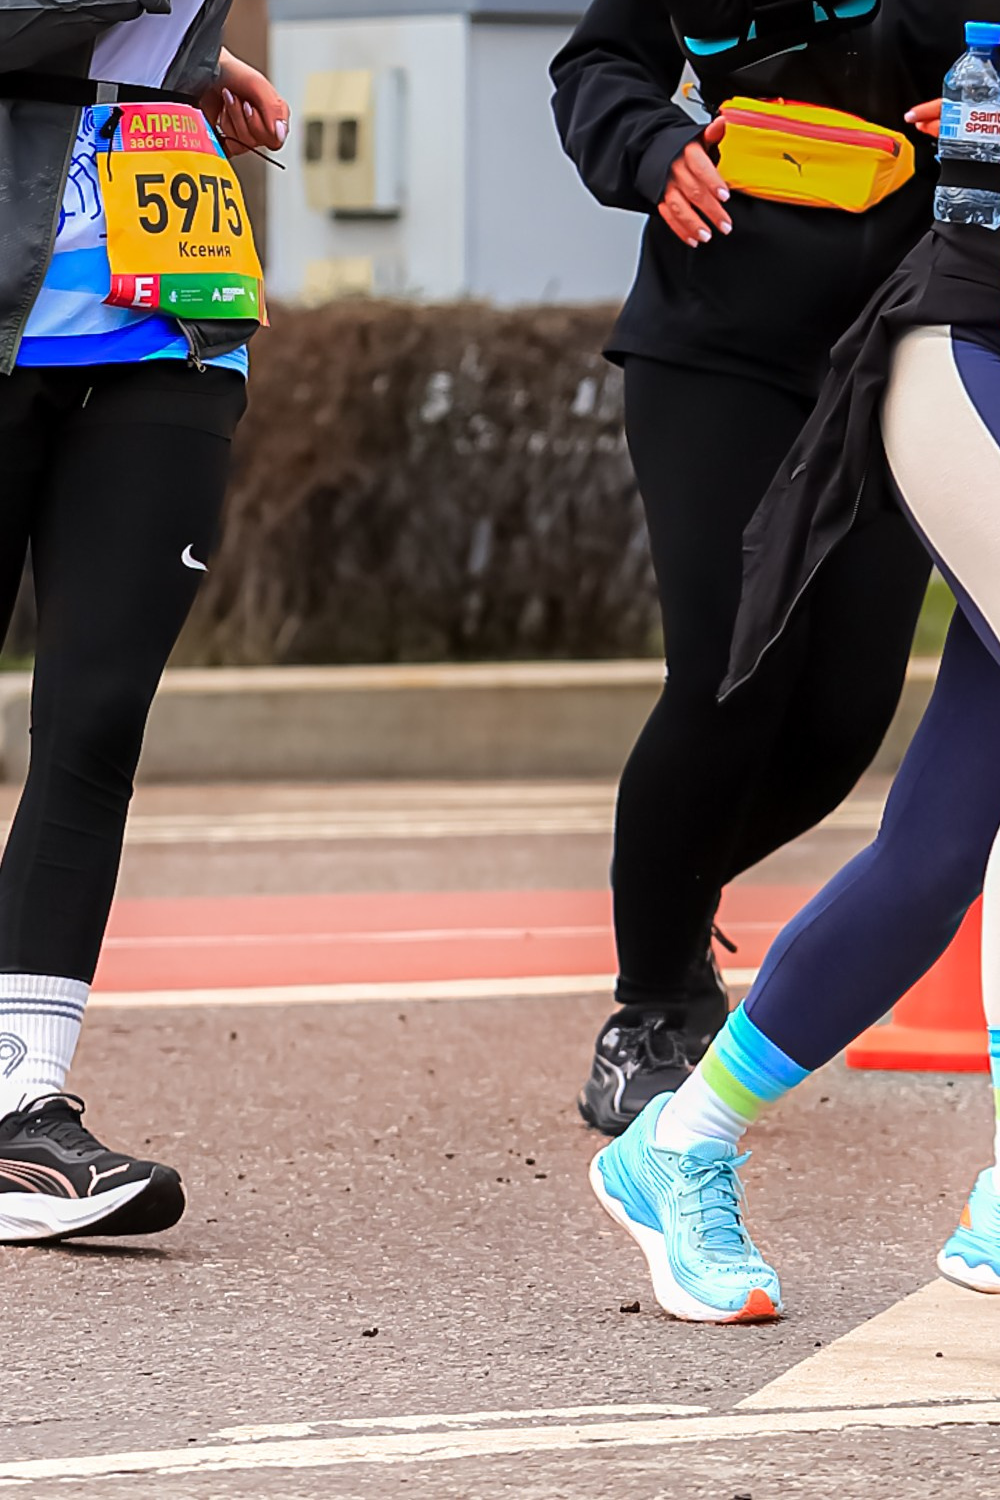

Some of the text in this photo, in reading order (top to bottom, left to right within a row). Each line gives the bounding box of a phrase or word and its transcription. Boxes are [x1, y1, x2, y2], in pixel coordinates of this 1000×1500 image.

[129, 114, 198, 134] АПРЕЛЬ
[130, 134, 170, 149] забег
[182, 135, 189, 148] 5
[135, 173, 243, 237] 5975
[178, 241, 232, 258] Ксения
